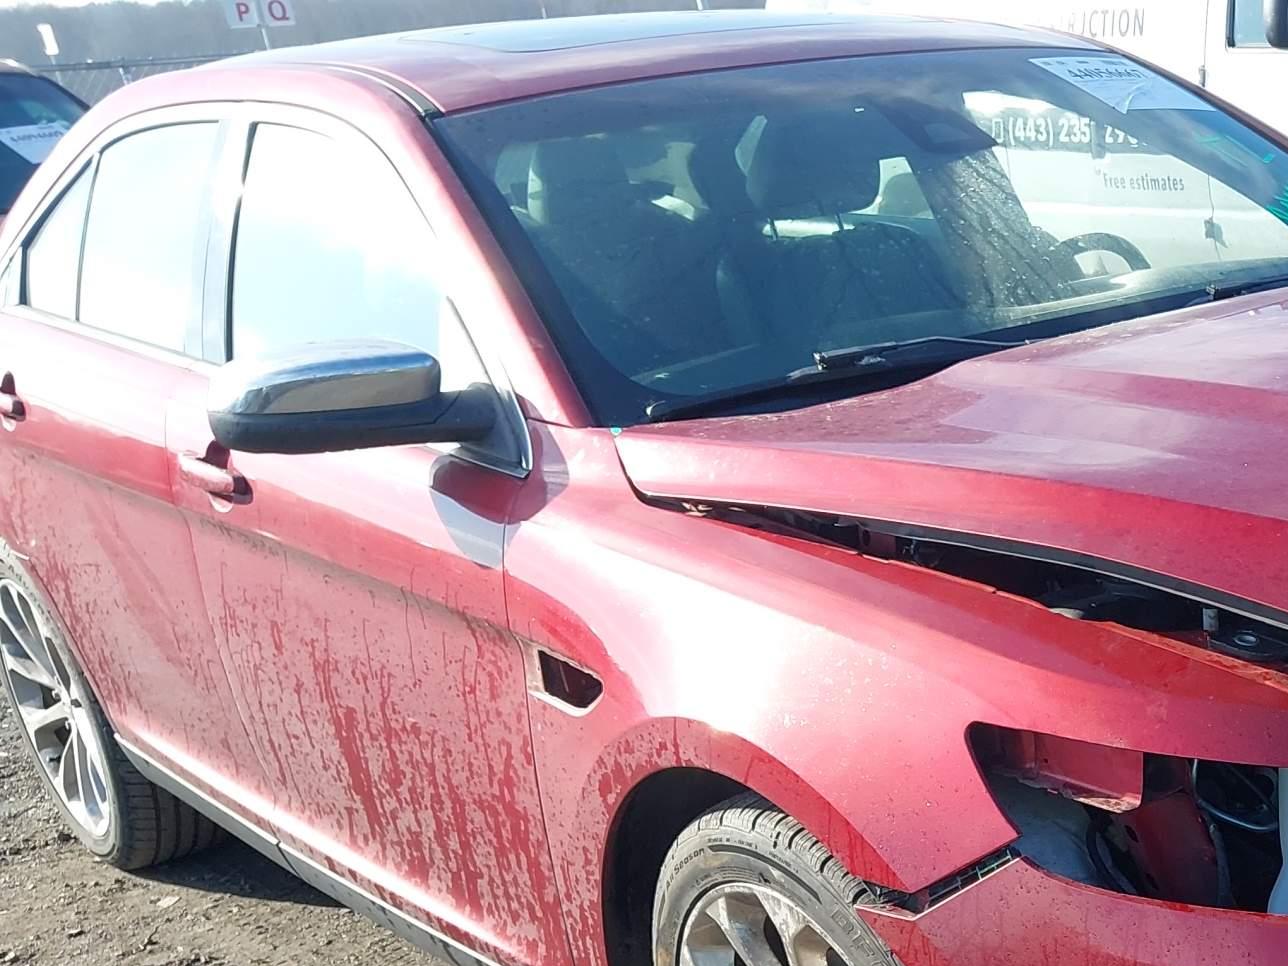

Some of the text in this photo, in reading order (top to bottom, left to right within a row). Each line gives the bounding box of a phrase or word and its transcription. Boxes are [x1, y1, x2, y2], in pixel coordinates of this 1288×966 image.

[235, 2, 250, 22] P
[267, 0, 290, 21] Q
[1008, 116, 1054, 146] (443)
[1058, 116, 1091, 144] 235
[1103, 174, 1185, 191] Free estimates
[673, 847, 706, 876] Season
